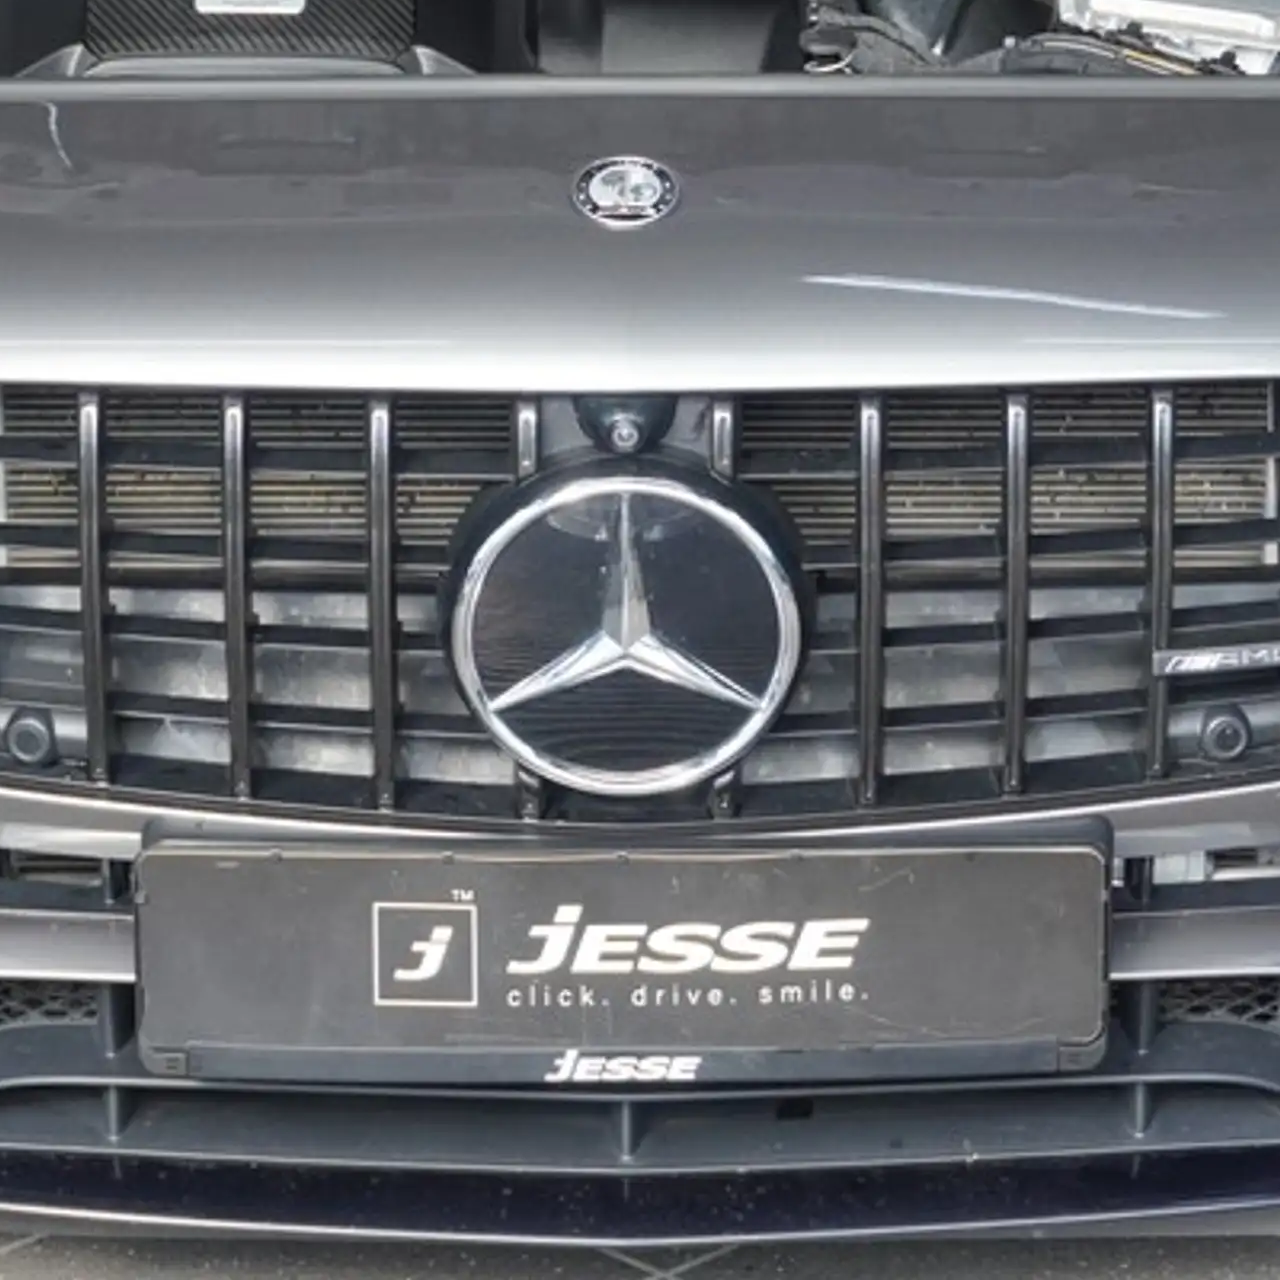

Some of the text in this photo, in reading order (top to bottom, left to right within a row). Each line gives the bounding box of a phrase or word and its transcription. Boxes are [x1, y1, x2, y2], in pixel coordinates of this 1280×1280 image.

[505, 979, 870, 1008] click. drive. smile.
